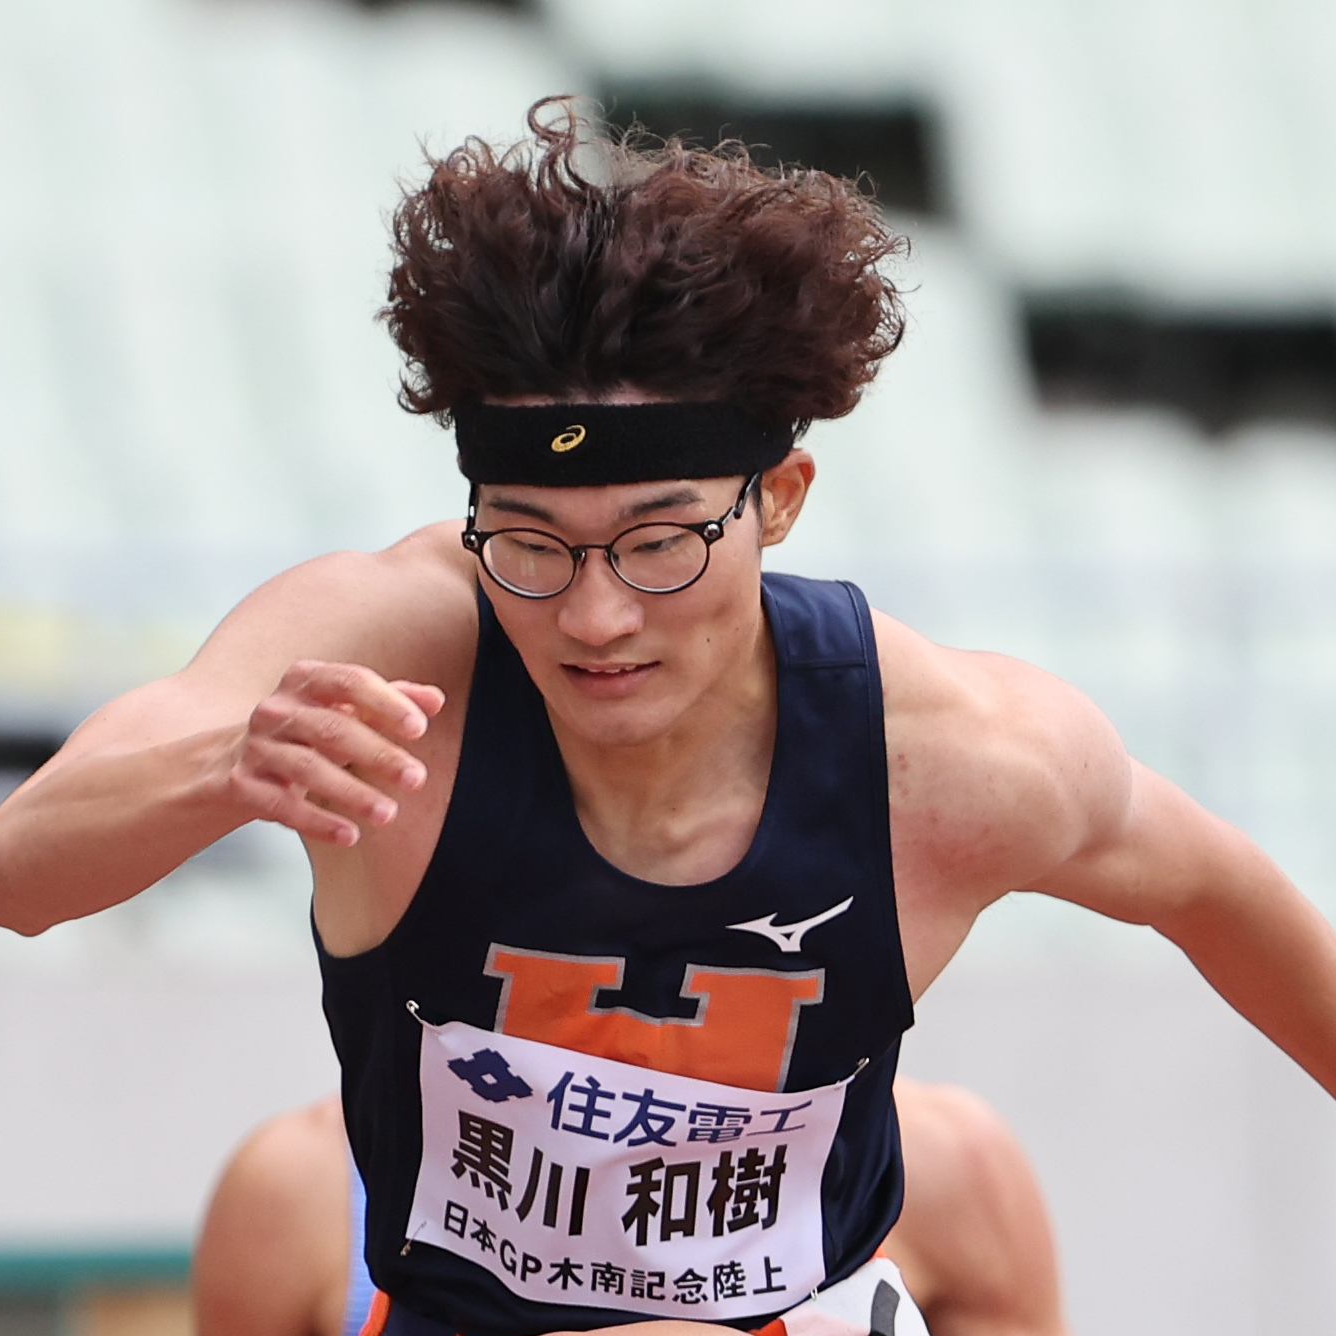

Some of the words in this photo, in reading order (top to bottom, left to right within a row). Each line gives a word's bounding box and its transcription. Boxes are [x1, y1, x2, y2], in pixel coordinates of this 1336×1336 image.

[546, 1070, 813, 1148] 住友電工
[450, 1109, 591, 1237] 黒川
[621, 1143, 788, 1247] 和樹
